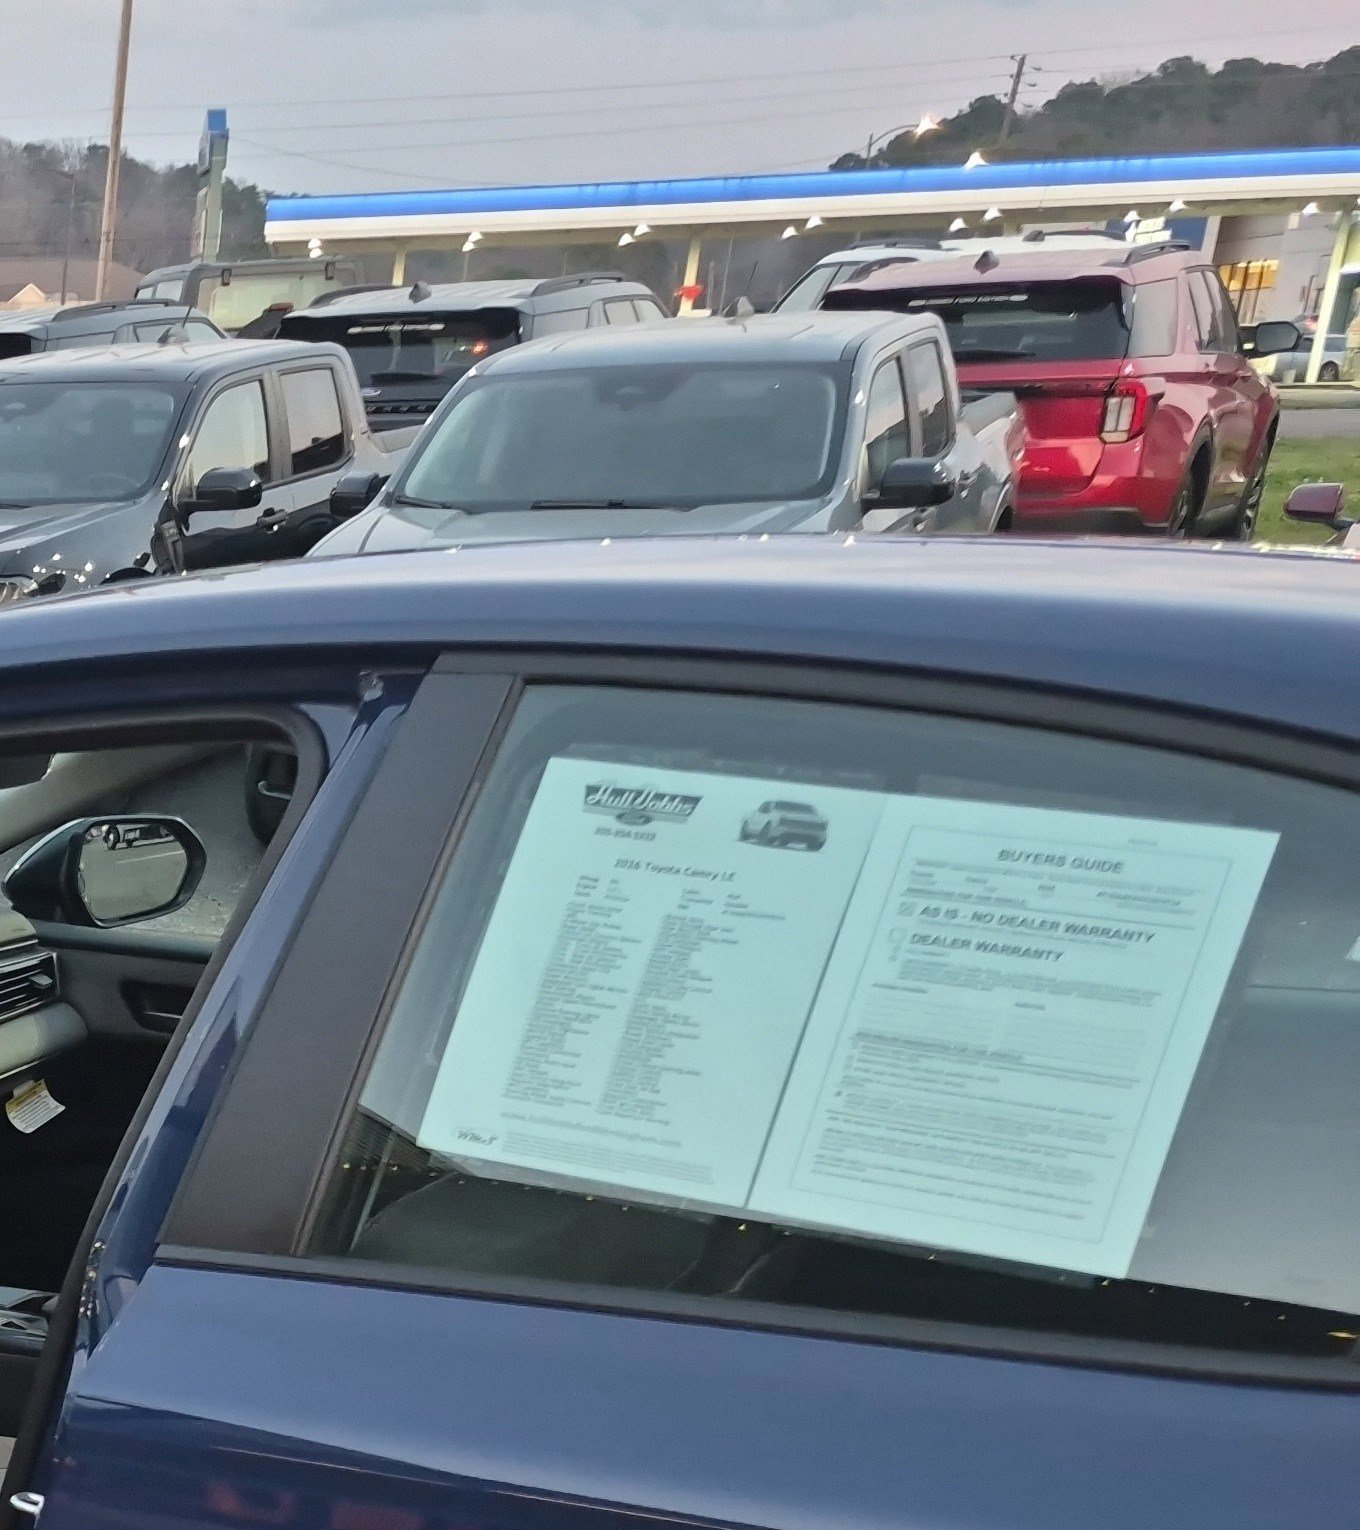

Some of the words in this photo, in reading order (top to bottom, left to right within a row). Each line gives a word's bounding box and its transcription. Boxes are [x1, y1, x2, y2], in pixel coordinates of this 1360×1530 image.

[997, 849, 1067, 868] BUYERS
[1070, 856, 1124, 874] GUIDE
[919, 905, 941, 919] AS
[943, 907, 958, 920] IS
[971, 910, 994, 923] NO
[997, 913, 1061, 932] DEALER
[1064, 921, 1156, 943] WARRANTY
[909, 932, 972, 949] DEALER
[975, 940, 1065, 961] WARRANTY
